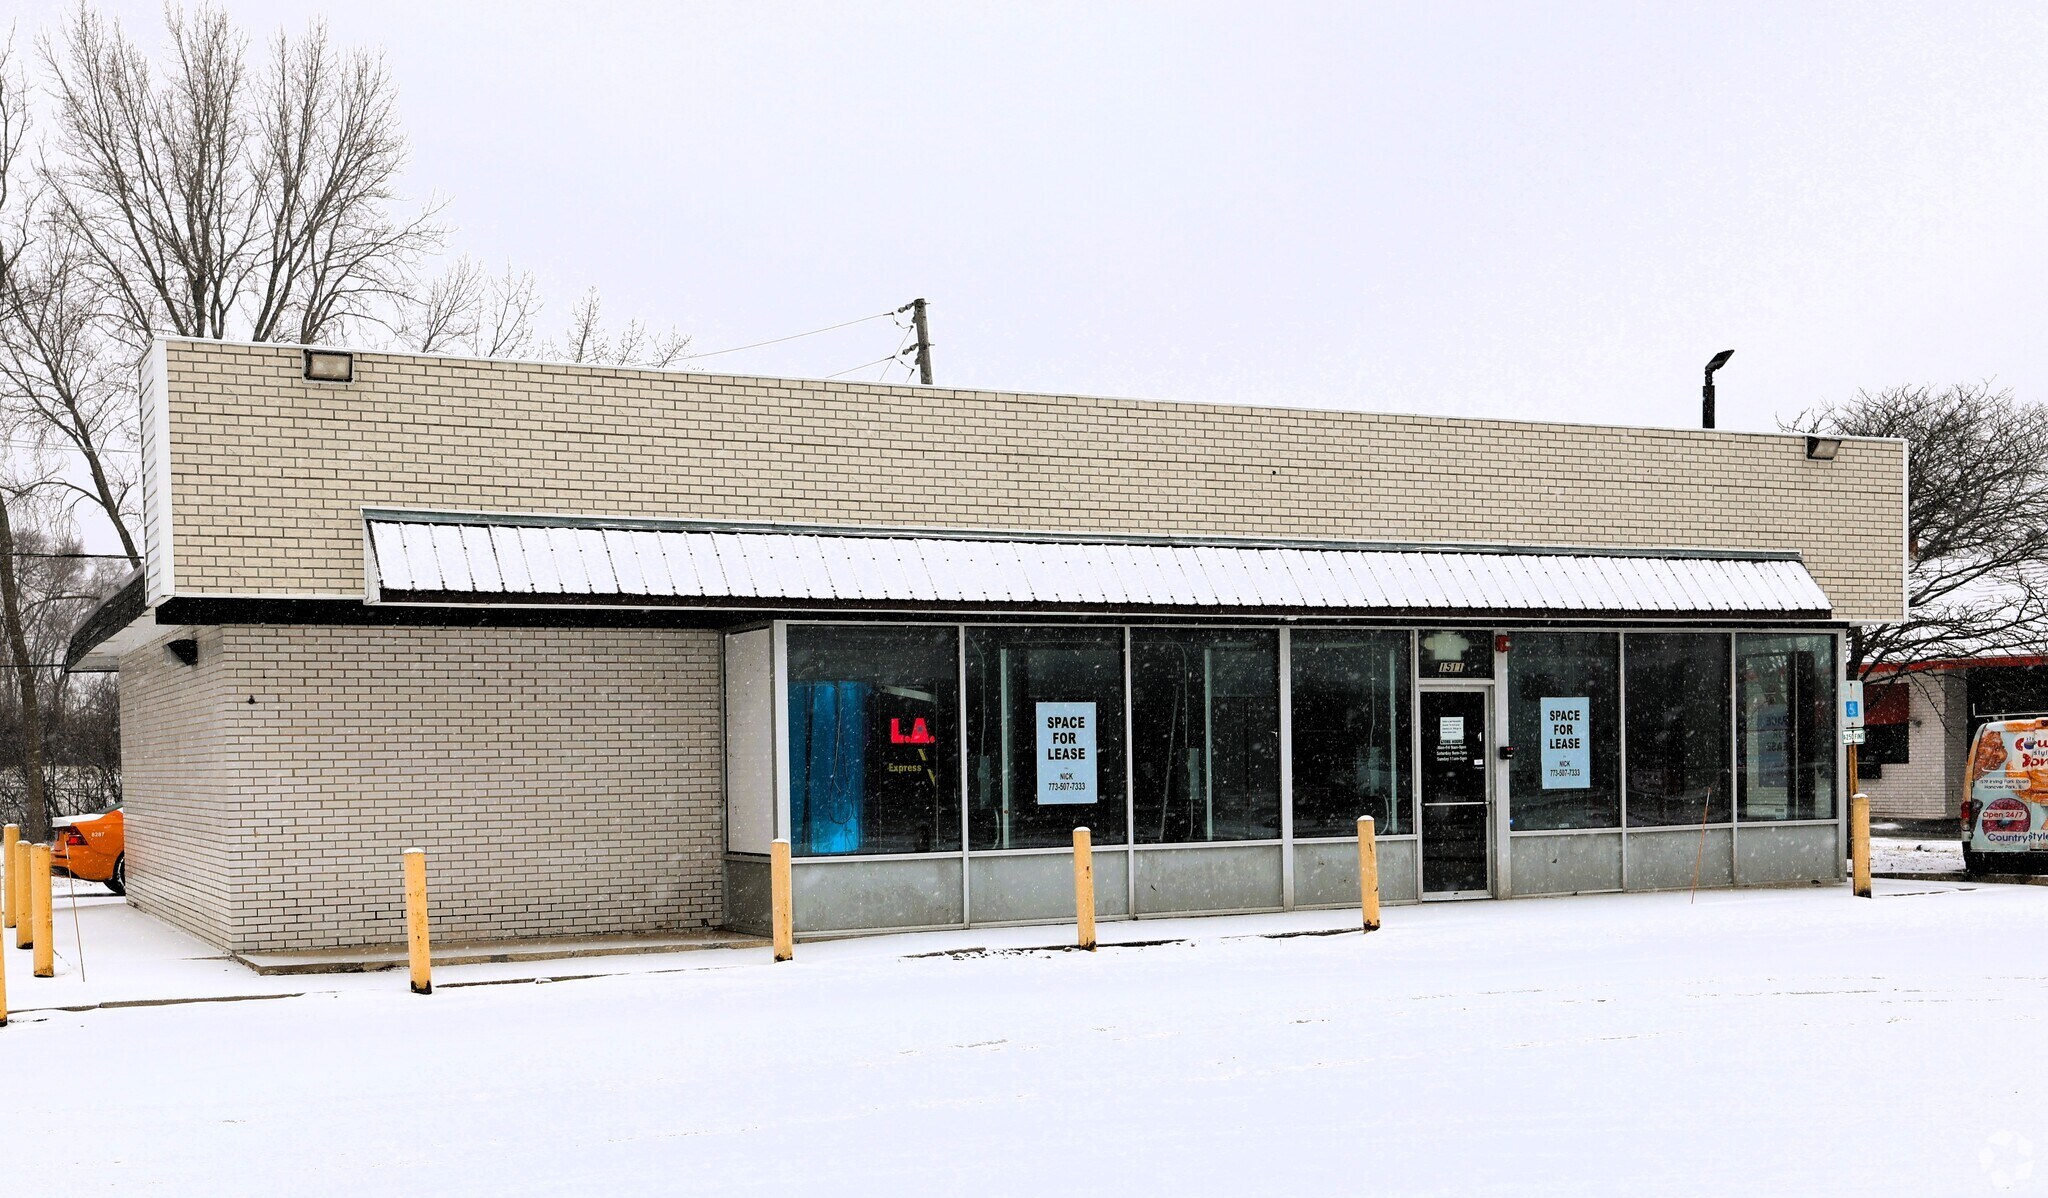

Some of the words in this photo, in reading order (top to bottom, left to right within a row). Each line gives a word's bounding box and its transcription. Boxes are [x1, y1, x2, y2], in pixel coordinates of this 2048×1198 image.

[1549, 710, 1581, 721] SPACE
[1047, 716, 1085, 729] SPACE
[891, 718, 935, 743] L.A.
[1553, 724, 1574, 736] FOR
[1052, 732, 1077, 744] FOR
[1549, 738, 1581, 750] LEASE
[1047, 748, 1086, 760] LEASE
[888, 763, 922, 773] Express
[1060, 773, 1074, 781] NICK
[1048, 782, 1086, 791] 773-507-7333
[1982, 811, 2003, 819] Open
